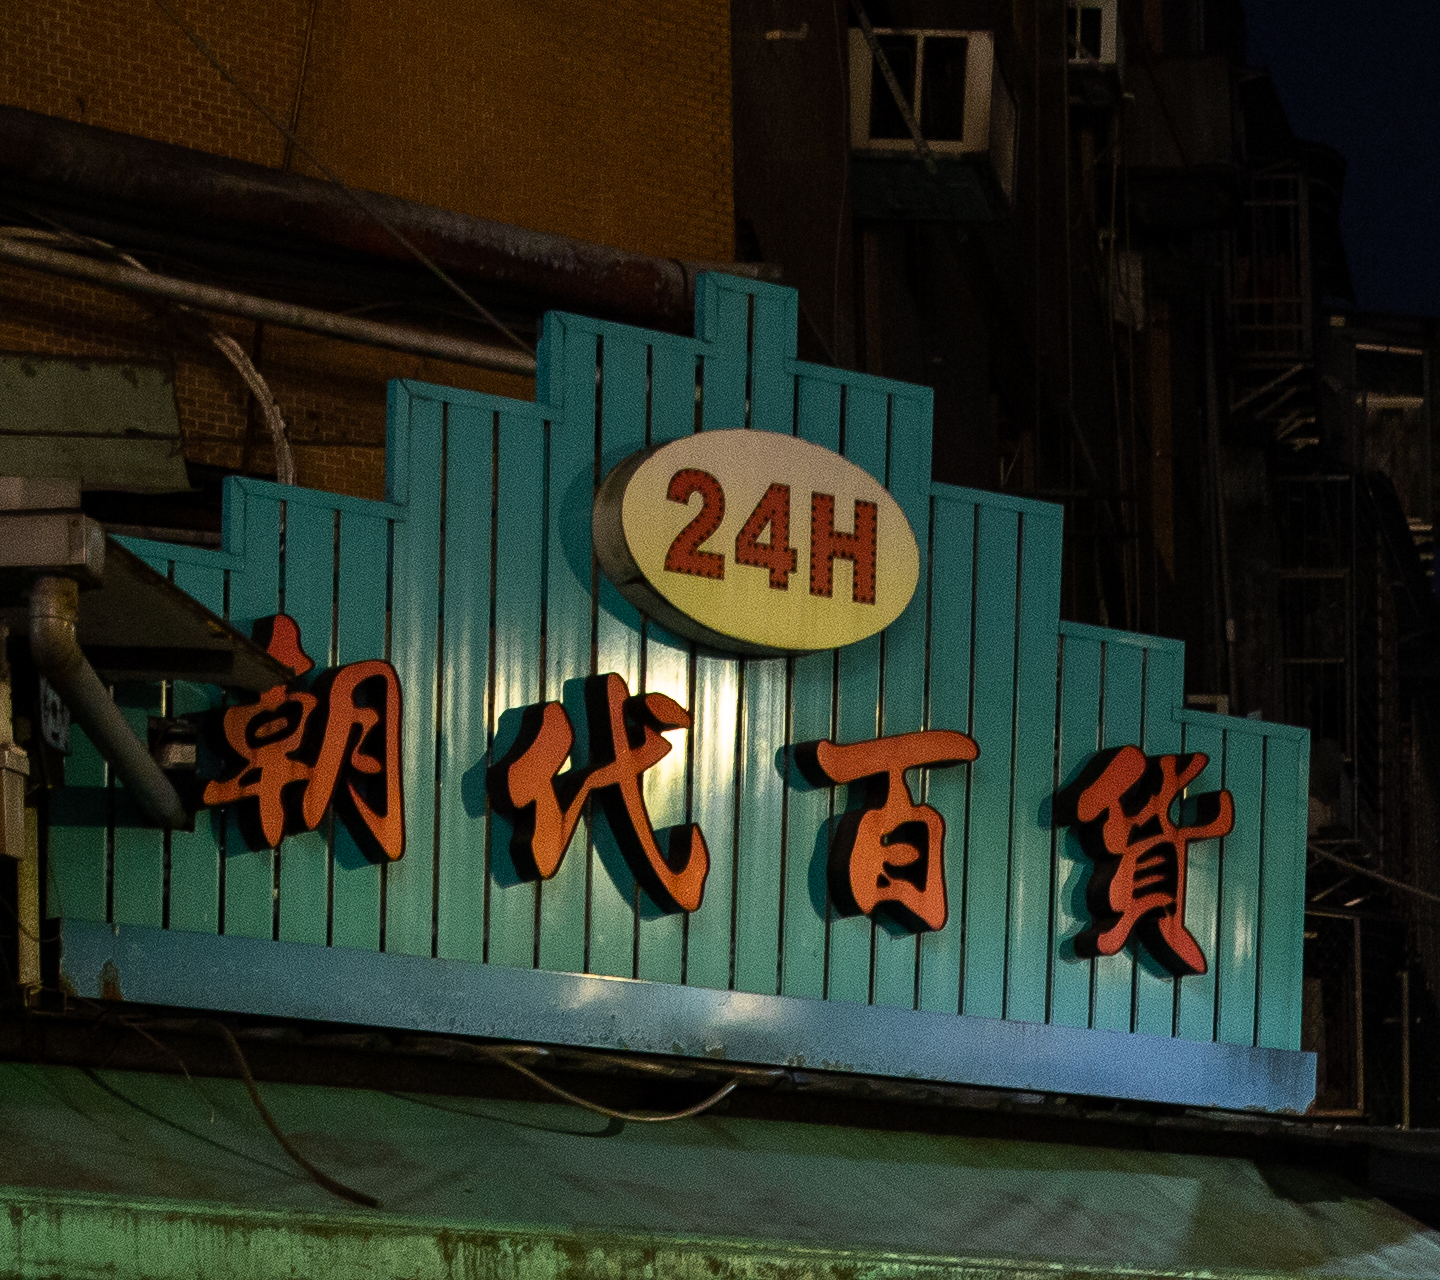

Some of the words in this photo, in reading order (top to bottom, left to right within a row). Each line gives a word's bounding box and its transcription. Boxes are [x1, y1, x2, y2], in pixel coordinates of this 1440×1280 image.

[664, 467, 878, 606] 24H
[202, 612, 1236, 976] 朝代百貨
